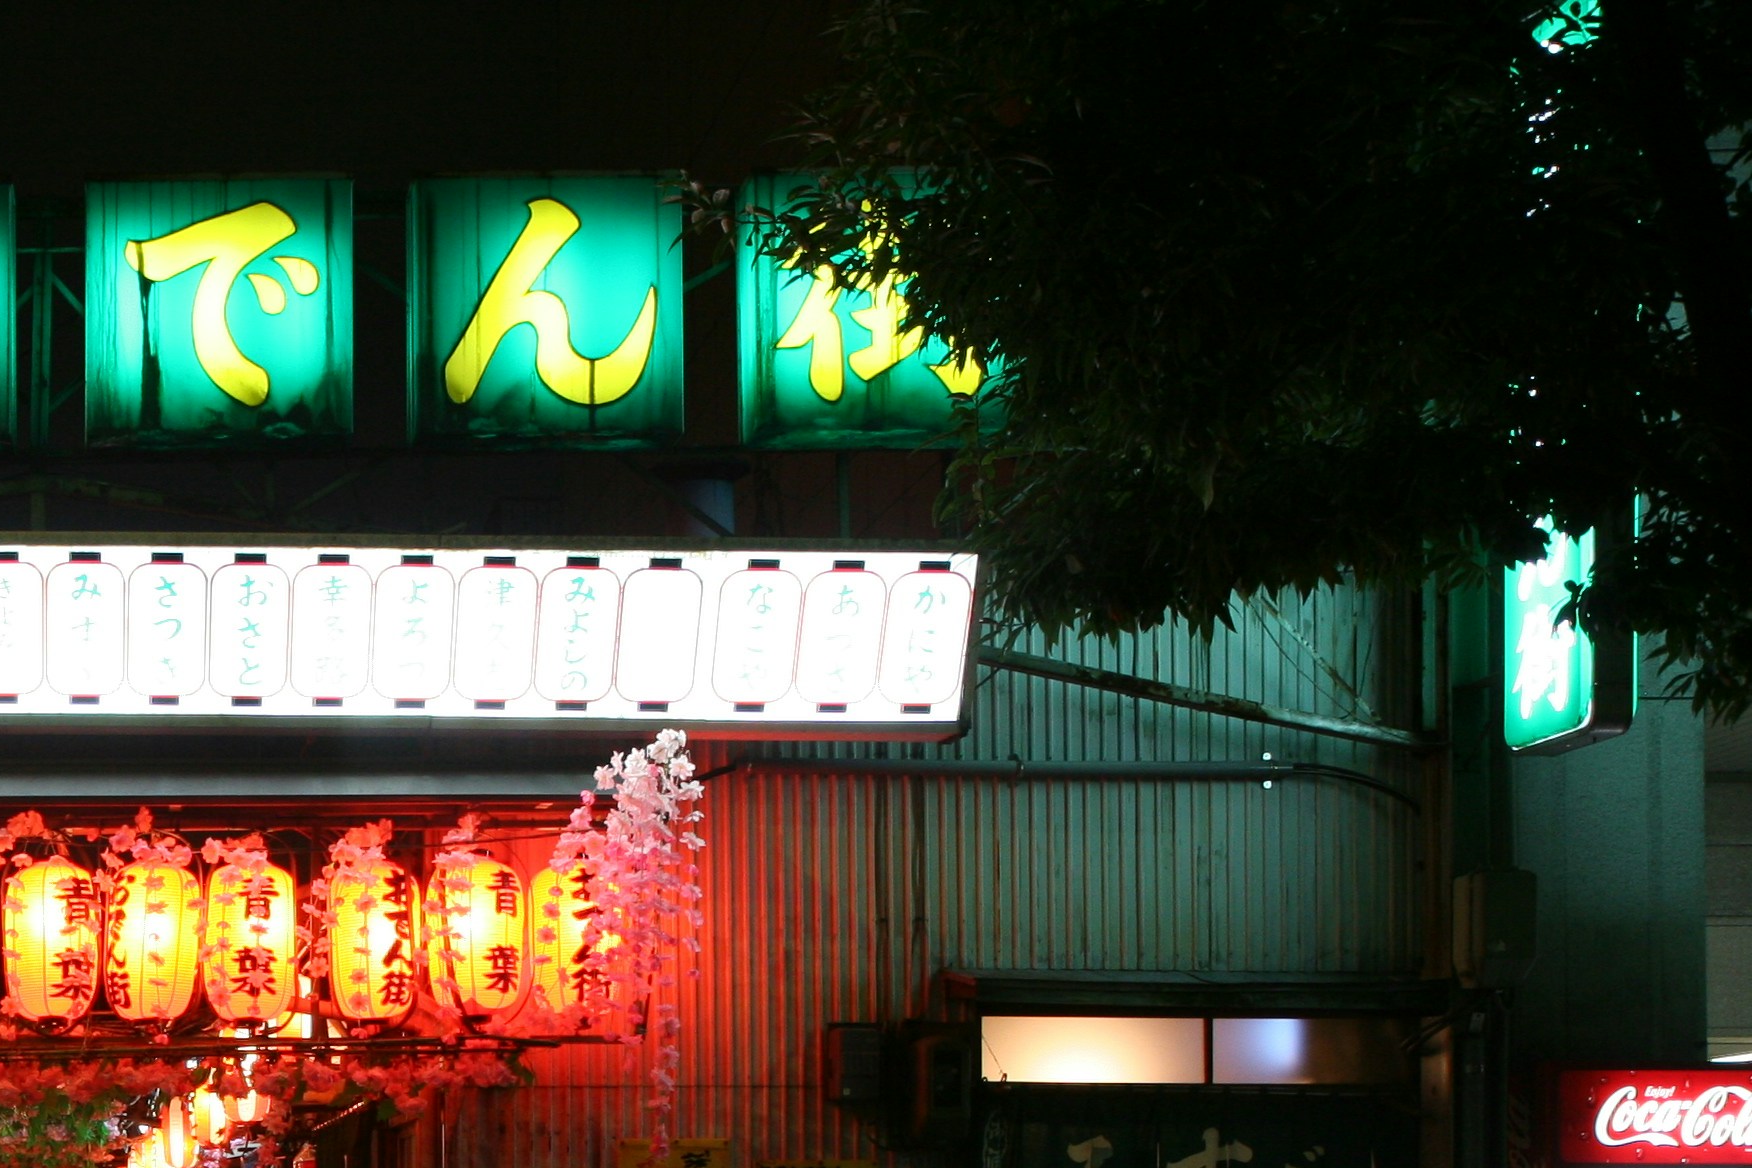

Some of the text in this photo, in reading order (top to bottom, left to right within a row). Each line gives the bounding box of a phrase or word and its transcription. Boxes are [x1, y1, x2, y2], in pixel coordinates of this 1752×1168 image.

[237, 574, 273, 687] おさと
[562, 575, 598, 691] みよしの
[483, 870, 523, 996] 青葉
[1594, 1085, 1752, 1148] Coca-Col
